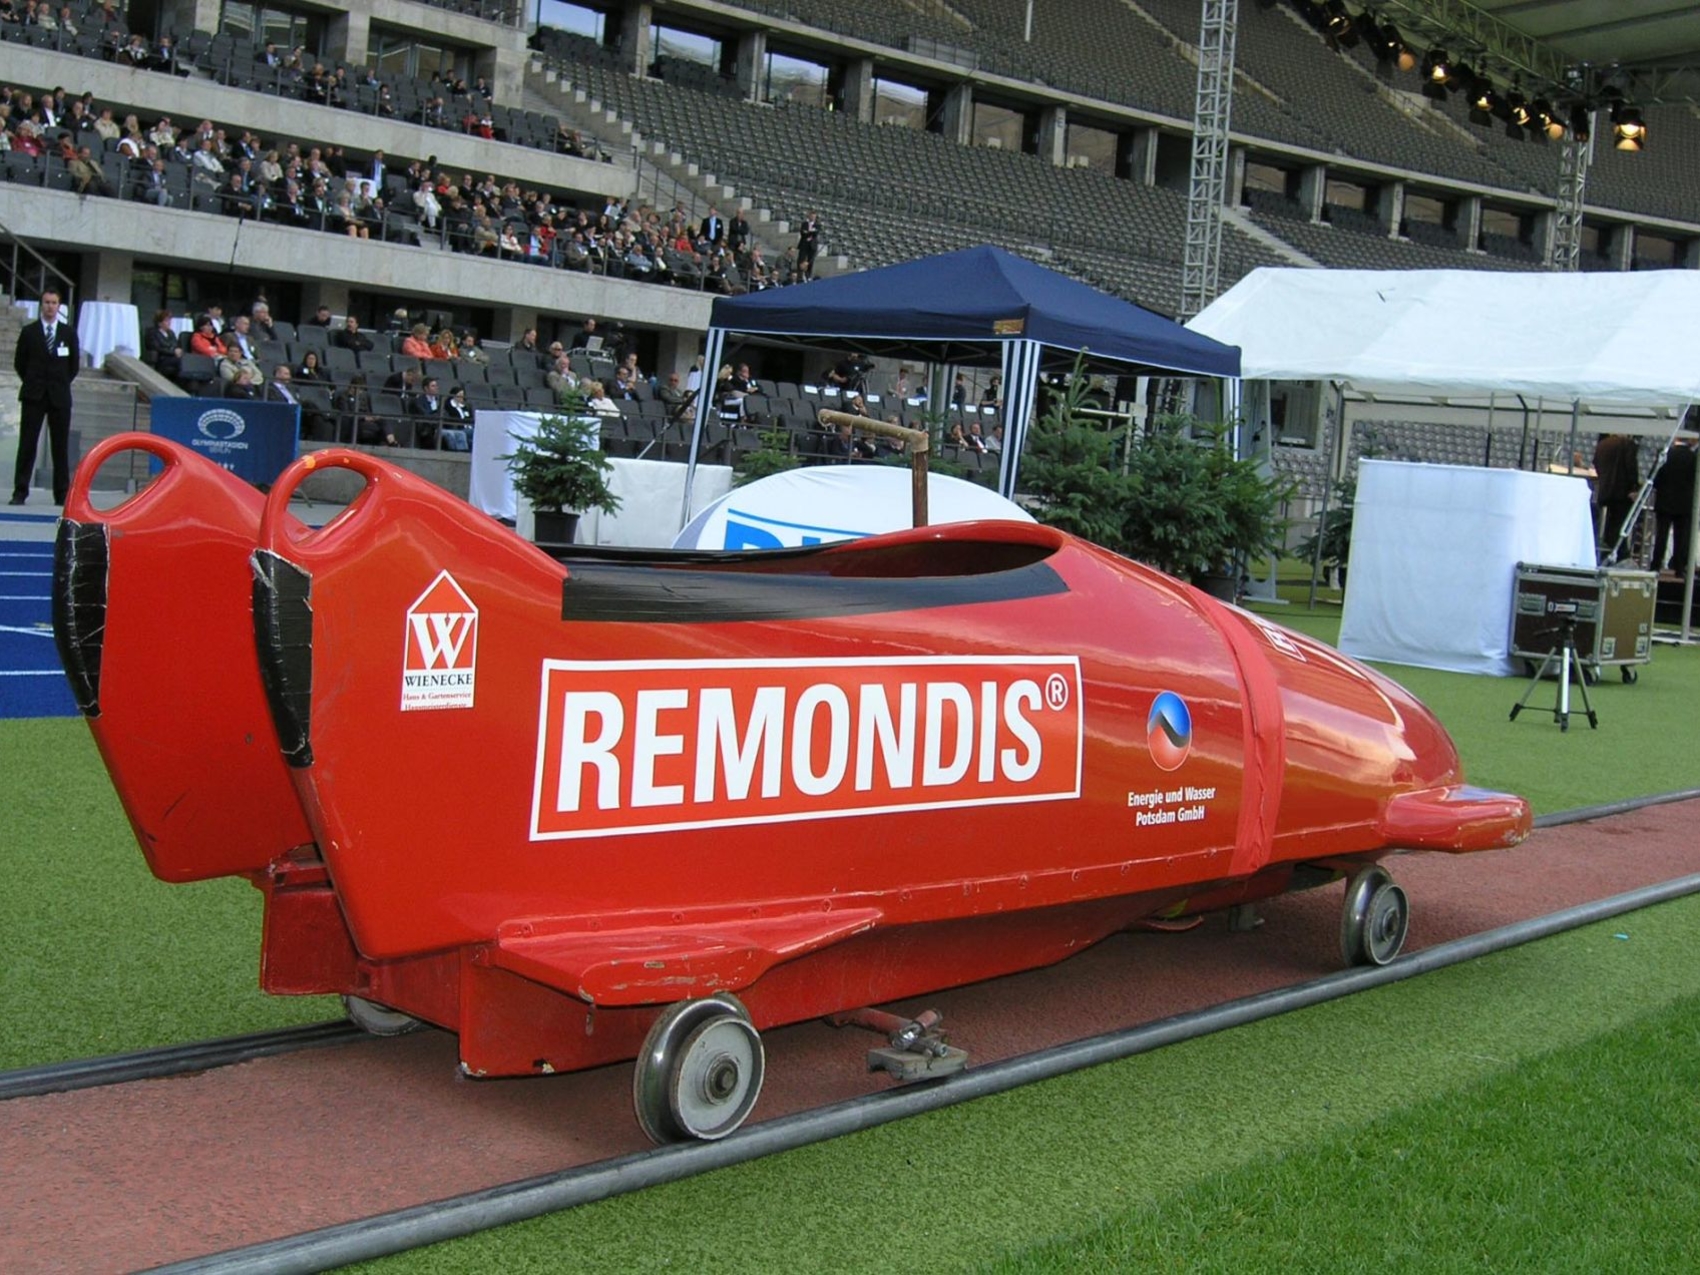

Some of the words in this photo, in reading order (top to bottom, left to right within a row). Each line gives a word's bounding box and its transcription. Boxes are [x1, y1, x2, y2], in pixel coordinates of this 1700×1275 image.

[409, 613, 475, 670] W
[404, 673, 473, 687] WIENECKE
[428, 691, 472, 701] Gartenservice
[1127, 789, 1164, 809] Energie
[1165, 786, 1183, 803] und
[1184, 786, 1216, 801] Wasser
[1136, 808, 1176, 827] Potsdam
[1177, 805, 1205, 822] GmbH
